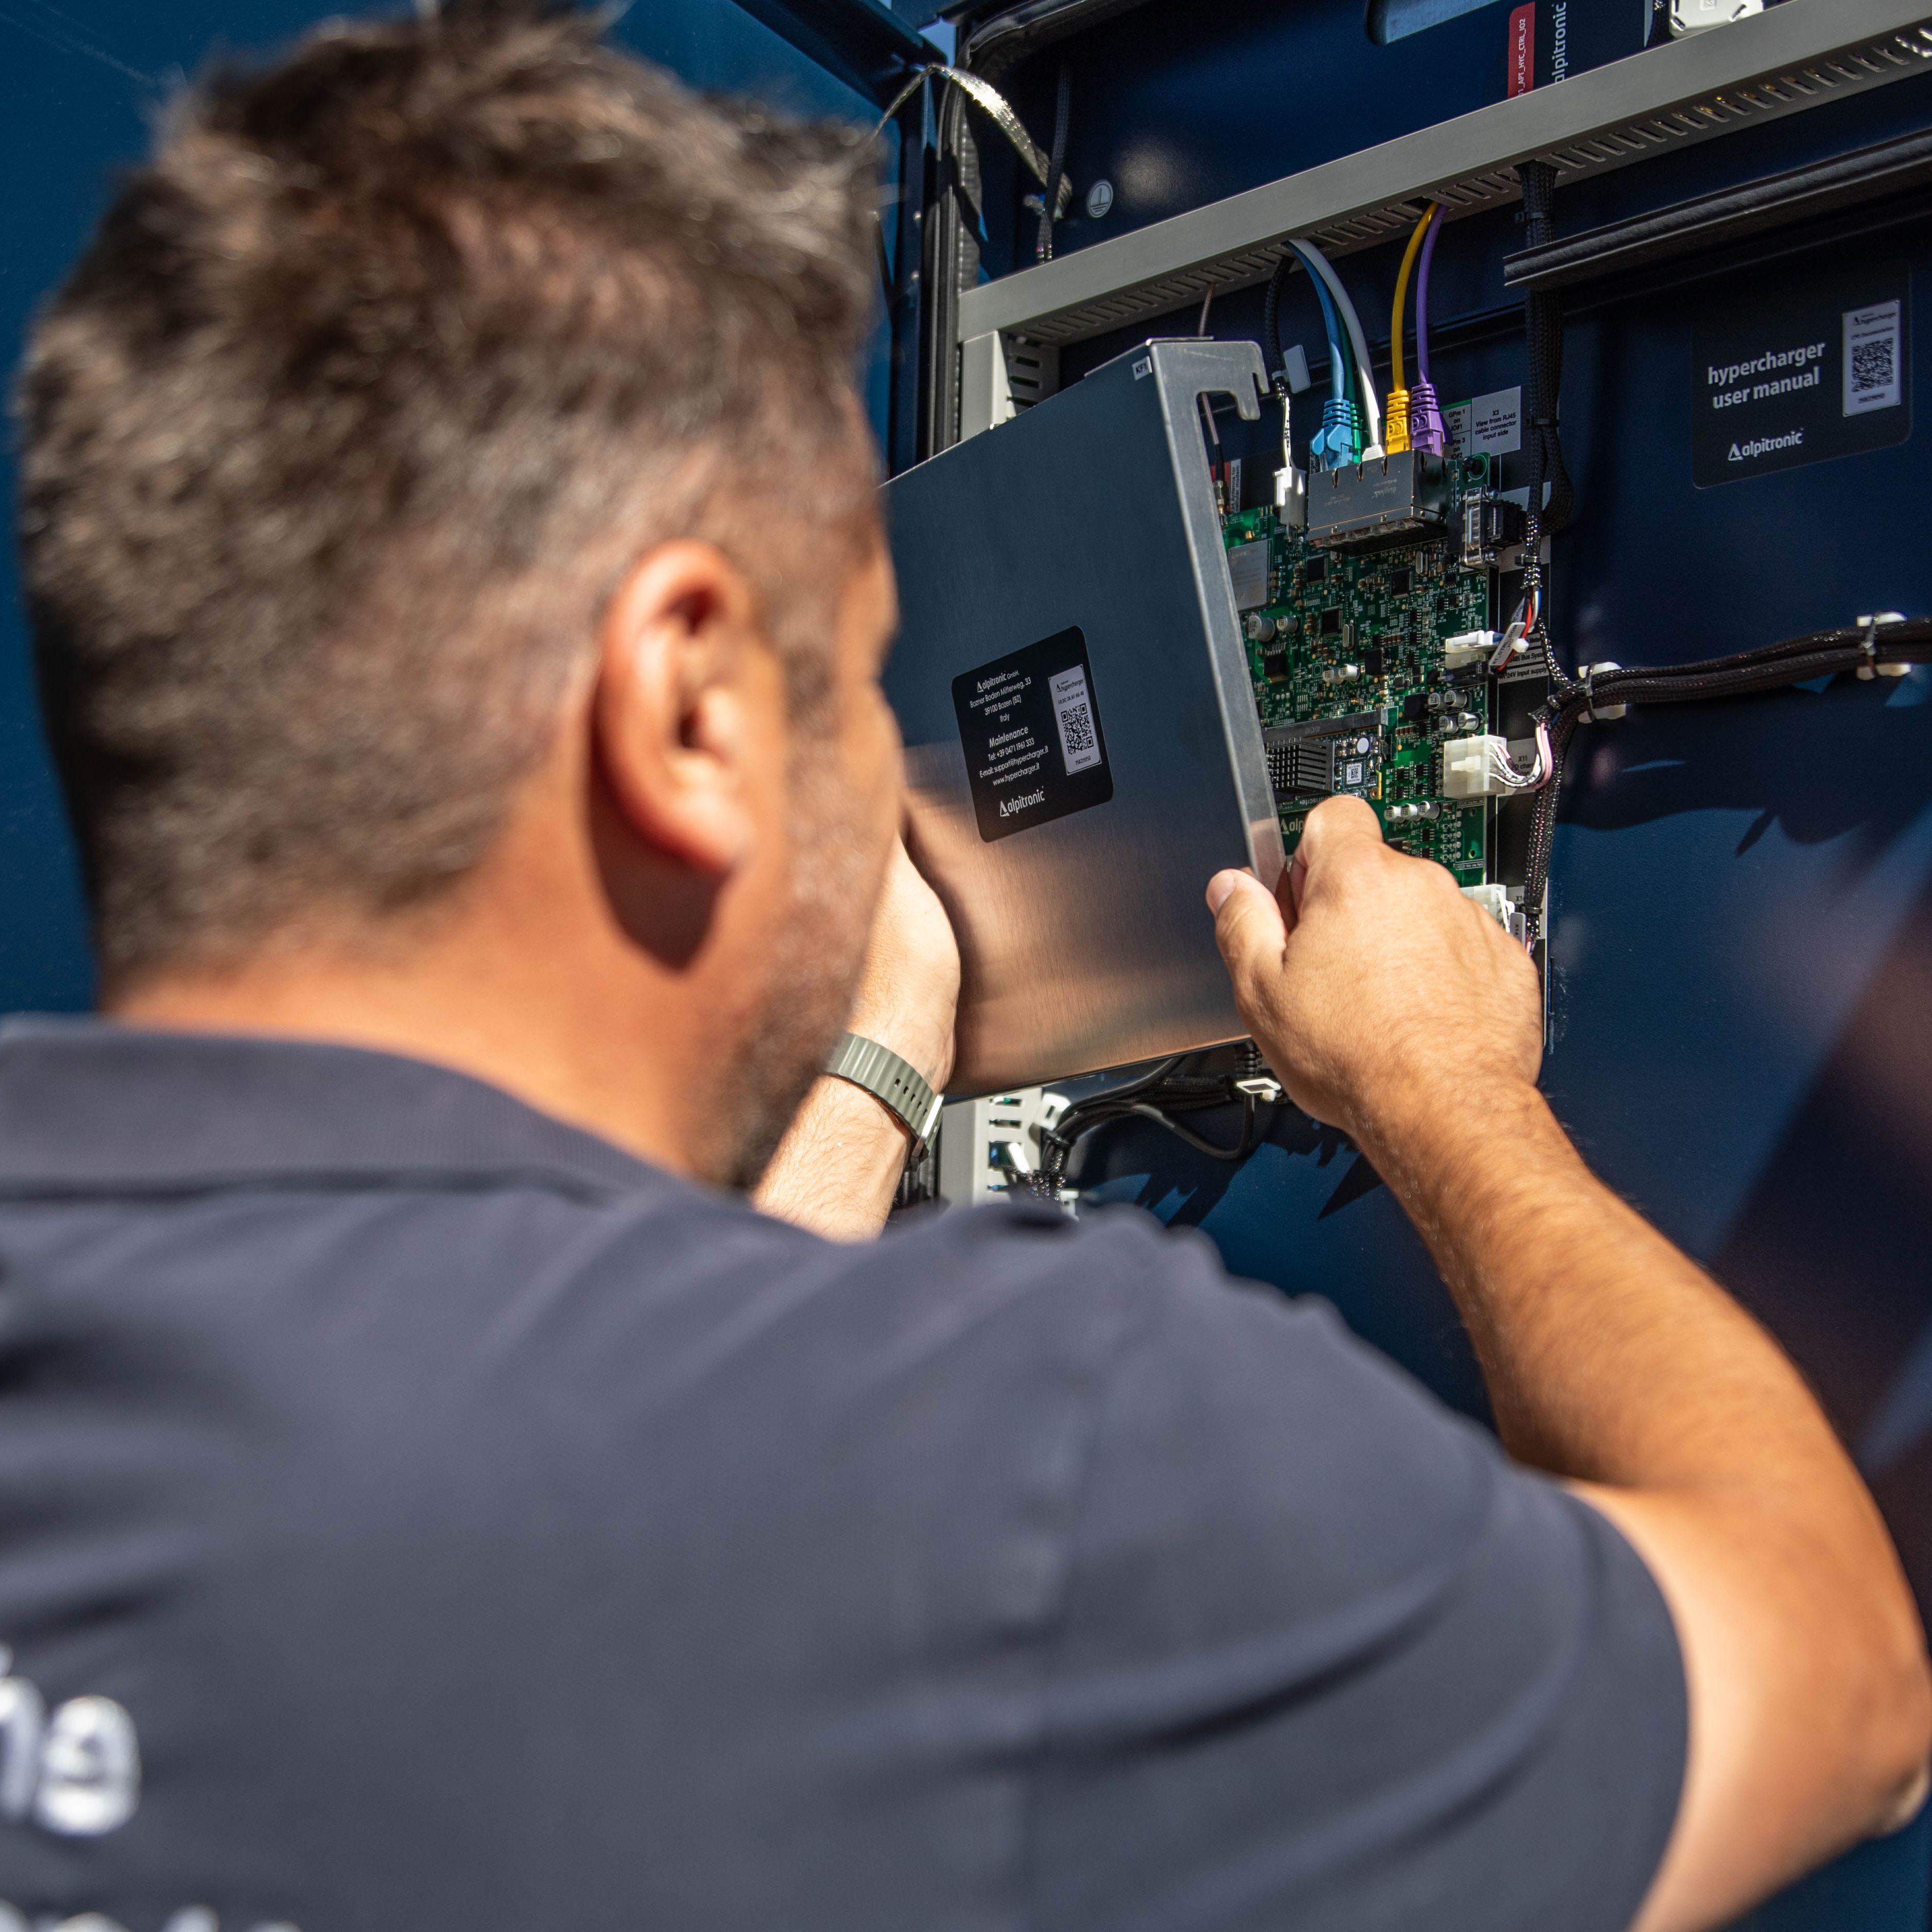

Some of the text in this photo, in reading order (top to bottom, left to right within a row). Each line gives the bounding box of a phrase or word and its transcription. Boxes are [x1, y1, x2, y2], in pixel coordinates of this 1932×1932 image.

[1552, 2, 1568, 83] alpitronic
[1708, 342, 1825, 387] hypercharger
[1713, 366, 1820, 409] user manual
[1490, 420, 1517, 431] connector
[1502, 413, 1516, 421] RJ45
[1741, 430, 1803, 457] alpitronic
[982, 673, 1007, 689] alpitronic
[1530, 667, 1547, 675] supply
[970, 677, 1031, 708] Bozner Boden Mitterweg, 33
[1061, 678, 1083, 692] hypercharger
[984, 694, 1022, 715] 39100 Bozen (BZ)
[1000, 713, 1010, 722] Italy
[989, 727, 1029, 748] Maintenance
[1005, 744, 1016, 755] 0471
[1016, 741, 1026, 750] 1961
[1026, 737, 1035, 747] 333
[994, 746, 1049, 773] support@hypercharger.it
[993, 762, 1040, 786] www.hypercharger.it
[1008, 789, 1045, 813] alpitronic
